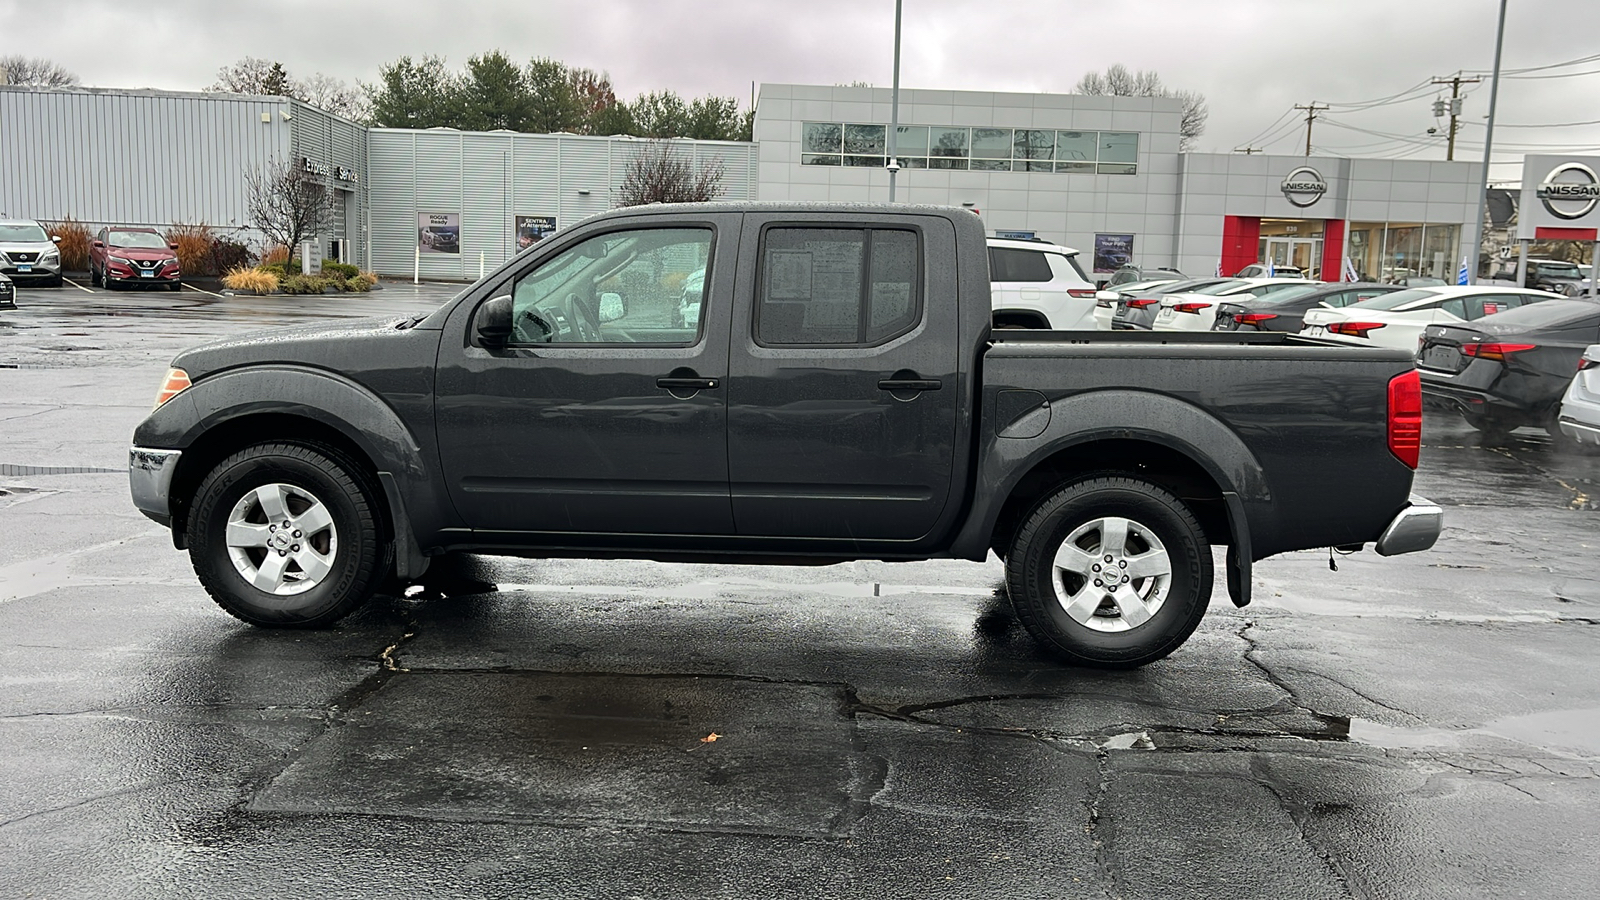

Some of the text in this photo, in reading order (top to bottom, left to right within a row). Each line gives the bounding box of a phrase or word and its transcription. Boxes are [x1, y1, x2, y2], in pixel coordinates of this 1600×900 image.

[306, 157, 358, 182] Express Service
[1286, 182, 1324, 190] NISSAN
[1544, 186, 1600, 196] NISSAN
[1181, 535, 1199, 615] COOPER
